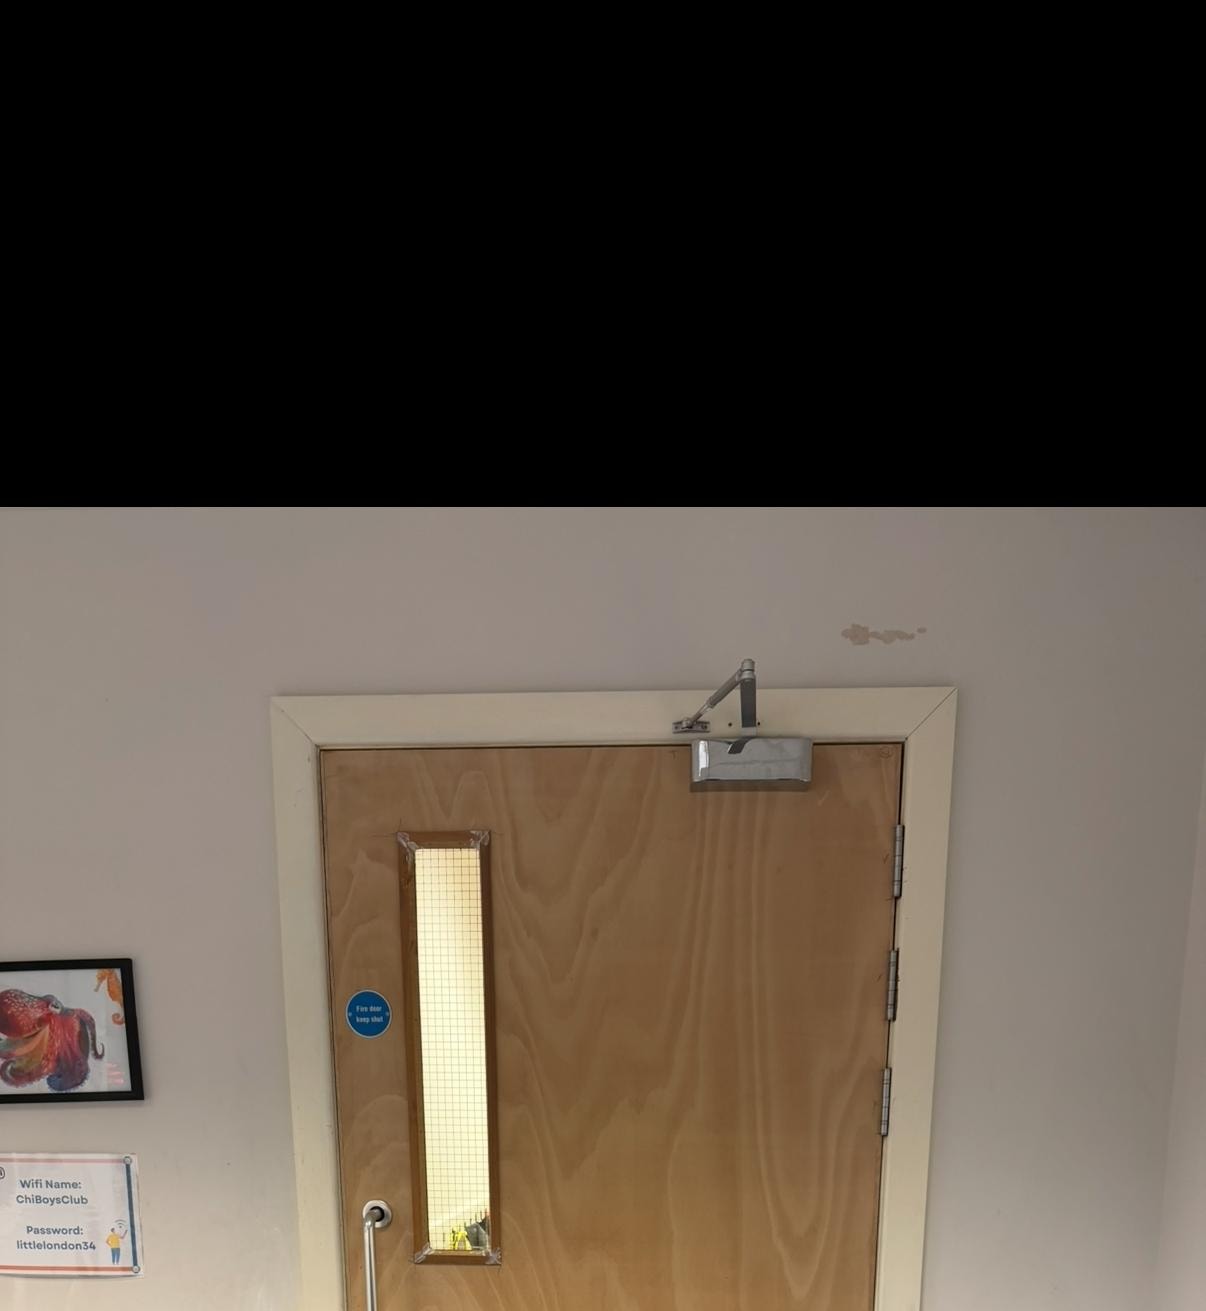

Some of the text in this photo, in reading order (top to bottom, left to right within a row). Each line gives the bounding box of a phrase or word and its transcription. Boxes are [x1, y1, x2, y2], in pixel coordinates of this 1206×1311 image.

[20, 1179, 82, 1189] Wifi Name:
[16, 1194, 88, 1206] ChiBoysClub
[26, 1226, 84, 1235] Password:
[16, 1240, 96, 1250] littlelondon34
